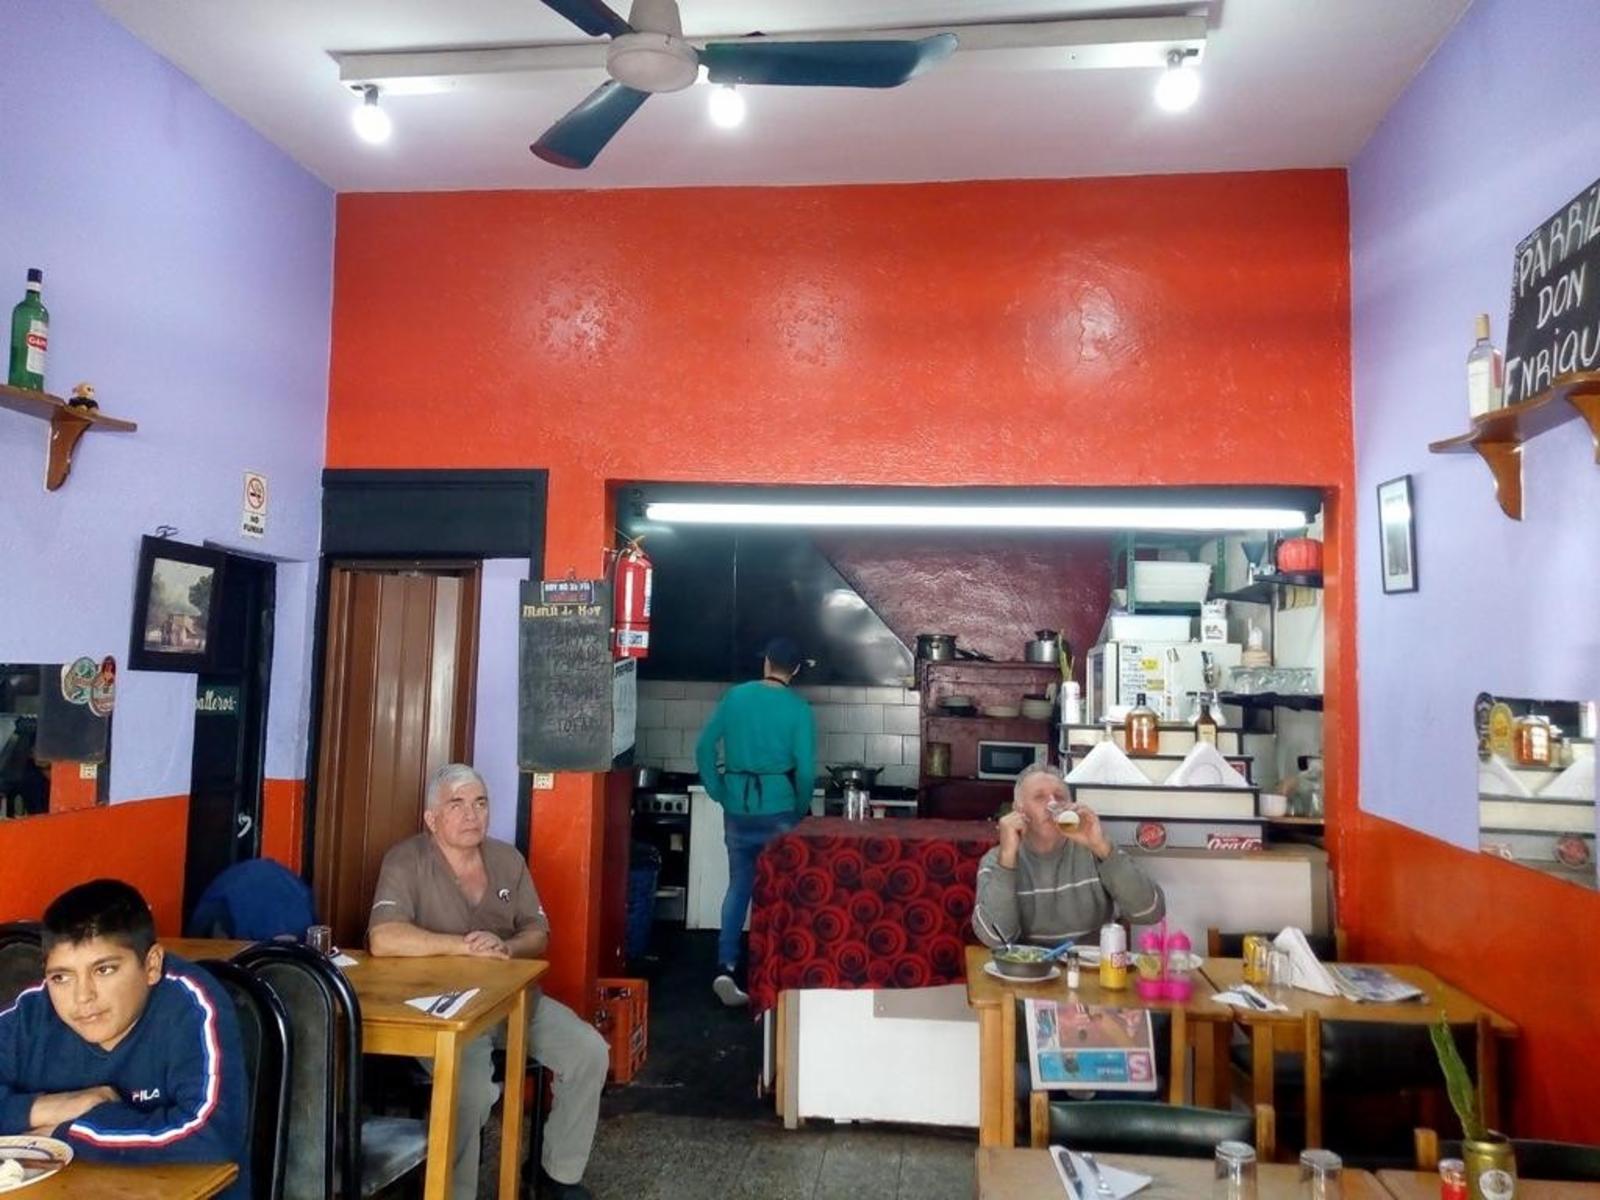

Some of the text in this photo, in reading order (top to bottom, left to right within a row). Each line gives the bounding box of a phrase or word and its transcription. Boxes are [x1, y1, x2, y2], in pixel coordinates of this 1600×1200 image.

[1537, 262, 1587, 330] DON
[250, 515, 260, 524] NO
[132, 1087, 160, 1102] FILA
